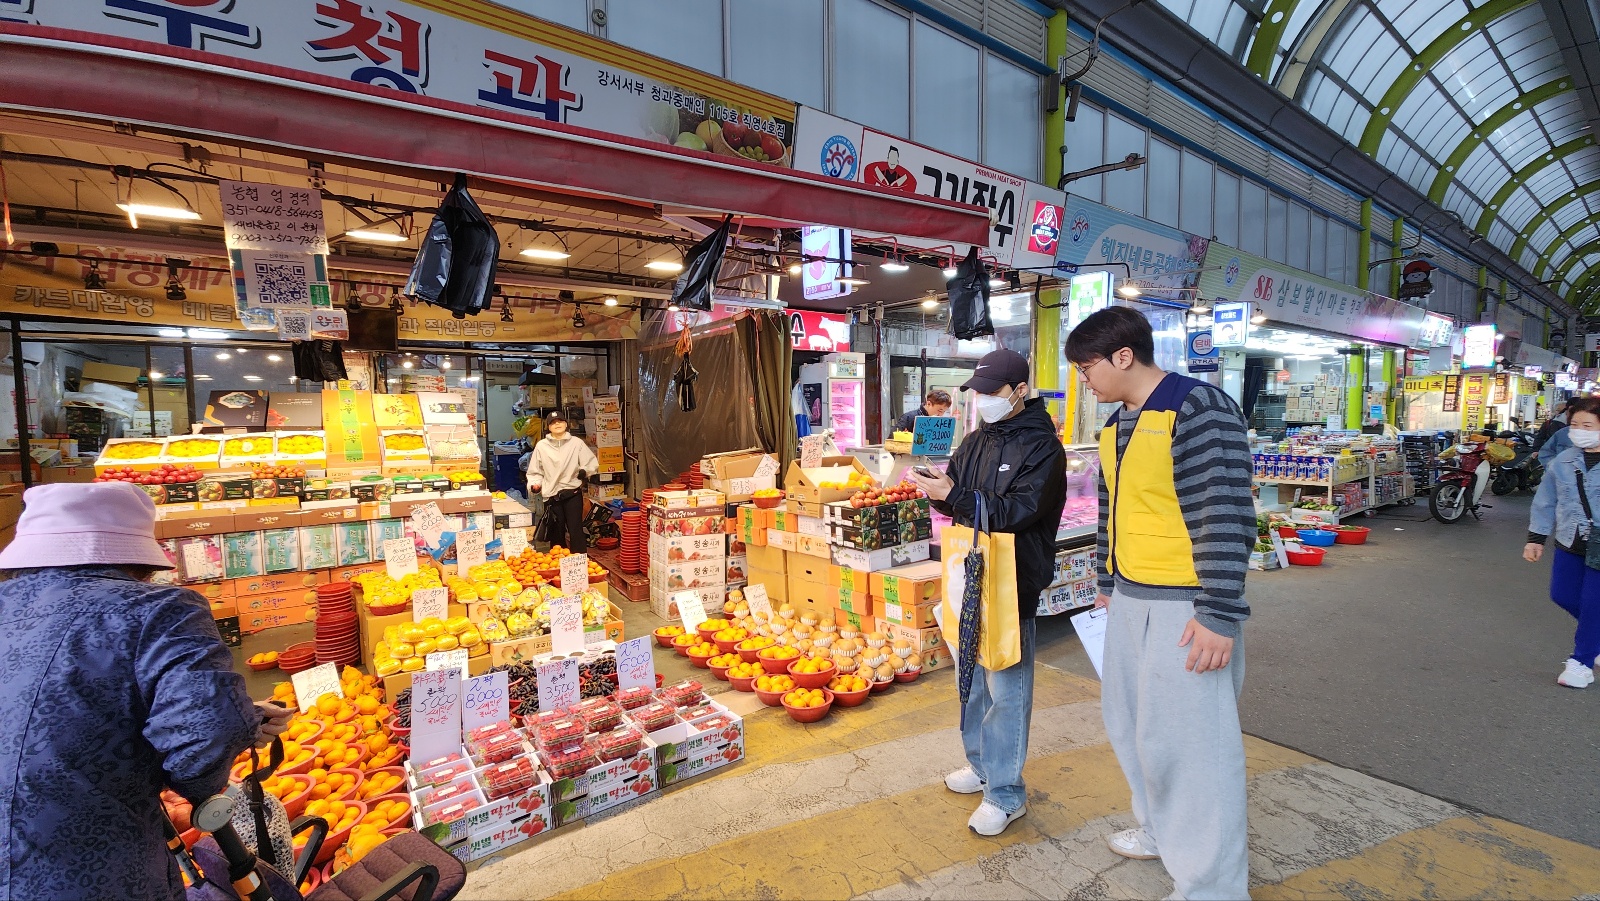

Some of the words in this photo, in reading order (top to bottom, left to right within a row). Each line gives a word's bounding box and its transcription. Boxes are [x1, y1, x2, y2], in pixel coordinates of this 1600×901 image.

[597, 70, 645, 97] 강서서부
[651, 85, 705, 116] 청과중매인
[710, 103, 738, 124] 115호
[742, 112, 785, 140] 직영4호점
[976, 167, 997, 180] PREMIUM
[997, 174, 1009, 184] MEAT
[1010, 177, 1022, 187] SHOP
[231, 184, 258, 202] 농협
[233, 220, 280, 231] 새마을금고
[287, 222, 296, 231] 이
[1254, 274, 1273, 301] SB
[1276, 278, 1347, 316] 삼보할인마트
[14, 286, 155, 317] 카드대환영
[425, 318, 497, 337] 직원일동
[694, 539, 709, 549] 청송
[694, 566, 709, 576] 청송
[620, 651, 651, 673] 6000
[466, 688, 503, 709] 8000
[545, 681, 575, 700] 3500
[415, 693, 457, 713] 5000
[688, 737, 703, 750] 샛별
[704, 732, 720, 745] 딸기
[688, 757, 704, 770] 샛별
[704, 752, 721, 765] 딸기
[589, 770, 607, 784] 샛별
[607, 764, 627, 778] 딸기
[590, 792, 608, 807] 샛별
[609, 785, 629, 800] 딸기
[468, 811, 489, 828] 샛별
[490, 802, 514, 819] 딸기
[470, 836, 492, 853] 샛별
[493, 827, 517, 843] 딸기
